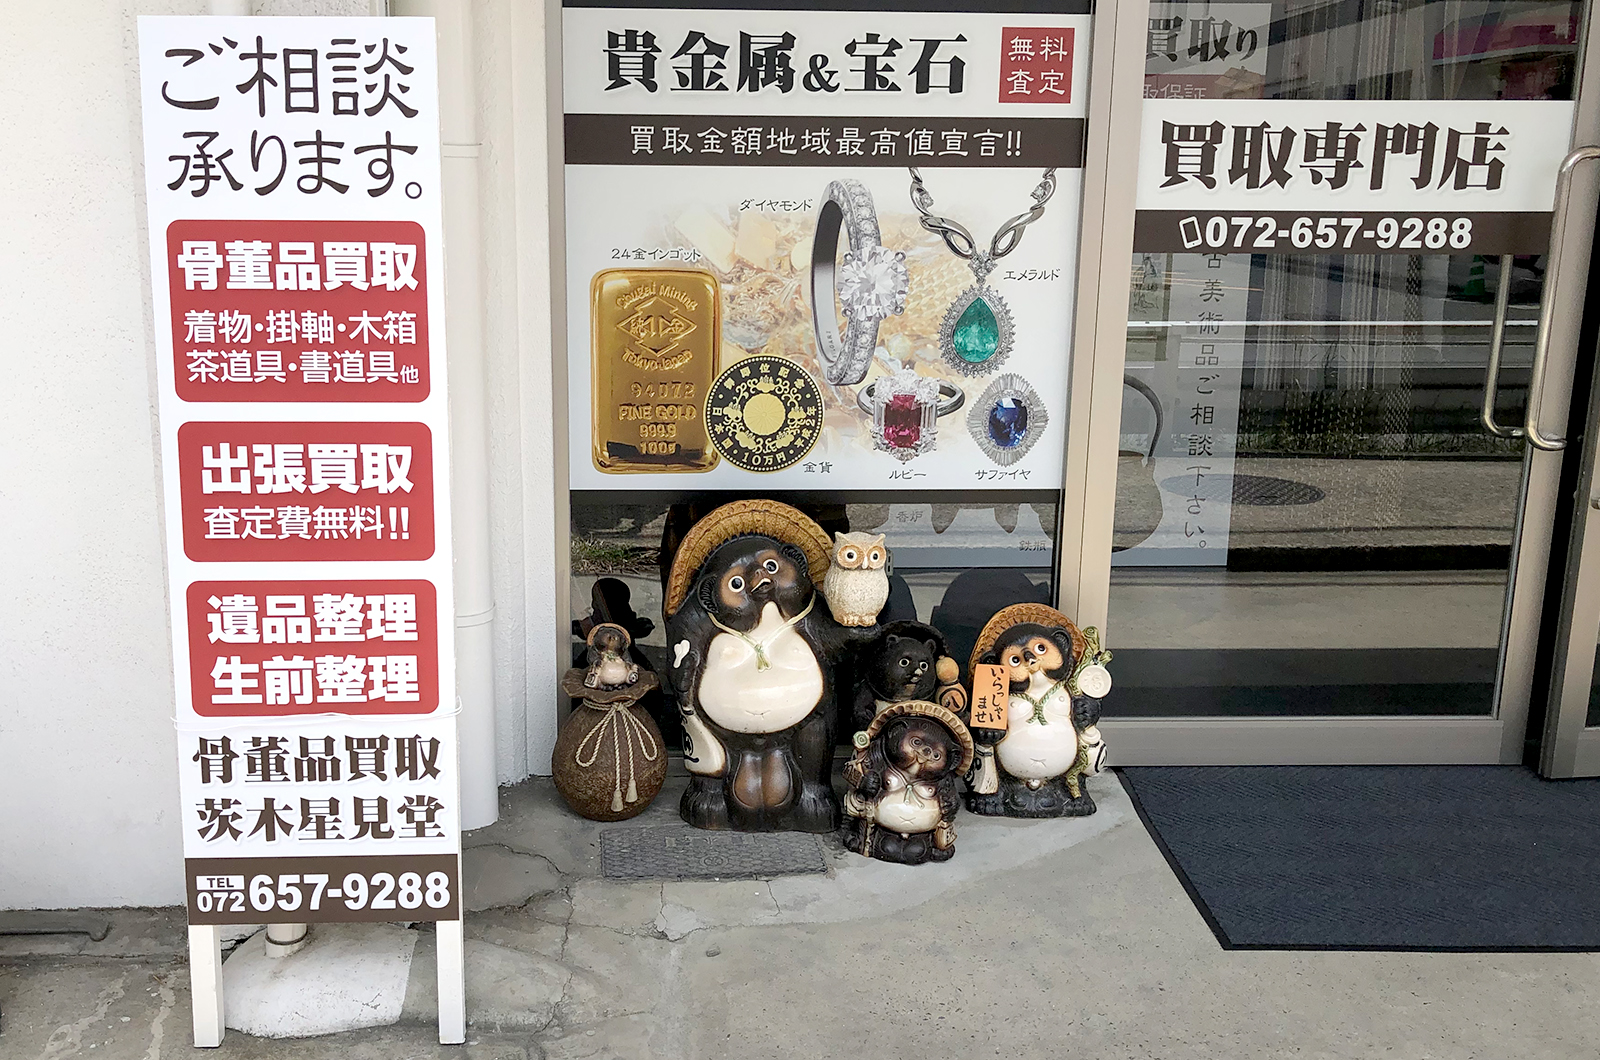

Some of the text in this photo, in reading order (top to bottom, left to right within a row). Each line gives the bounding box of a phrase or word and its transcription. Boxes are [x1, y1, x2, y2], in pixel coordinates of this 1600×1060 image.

[1006, 35, 1069, 62] 無料
[1146, 15, 1258, 62] 買取り
[161, 35, 419, 118] ご相談
[602, 28, 969, 94] 貴金属&宝石
[1006, 70, 1066, 97] 査定
[630, 124, 1023, 158] 買取金額地域最高値宣言!!
[1159, 119, 1511, 191] 買取専門店
[167, 129, 422, 199] 承ります。
[739, 197, 812, 212] ダイヤモンド
[1205, 216, 1473, 250] 072-657-9288
[177, 239, 419, 292] 骨董品買取
[1003, 268, 1061, 281] エメラルド
[619, 403, 697, 421] FINE GOLD
[201, 442, 415, 494] 出張買取
[802, 461, 833, 474] 金貨
[888, 469, 927, 480] ルビー
[974, 468, 1032, 481] サファイヤ
[203, 505, 410, 541] 査定費無料!!
[206, 592, 419, 645] 遺品整理
[210, 654, 420, 705] 生前整理
[192, 733, 442, 785] 骨董品買取
[195, 794, 446, 843] 茨木星見堂
[197, 870, 451, 913] 072 657-9288
[206, 877, 235, 889] TEL
